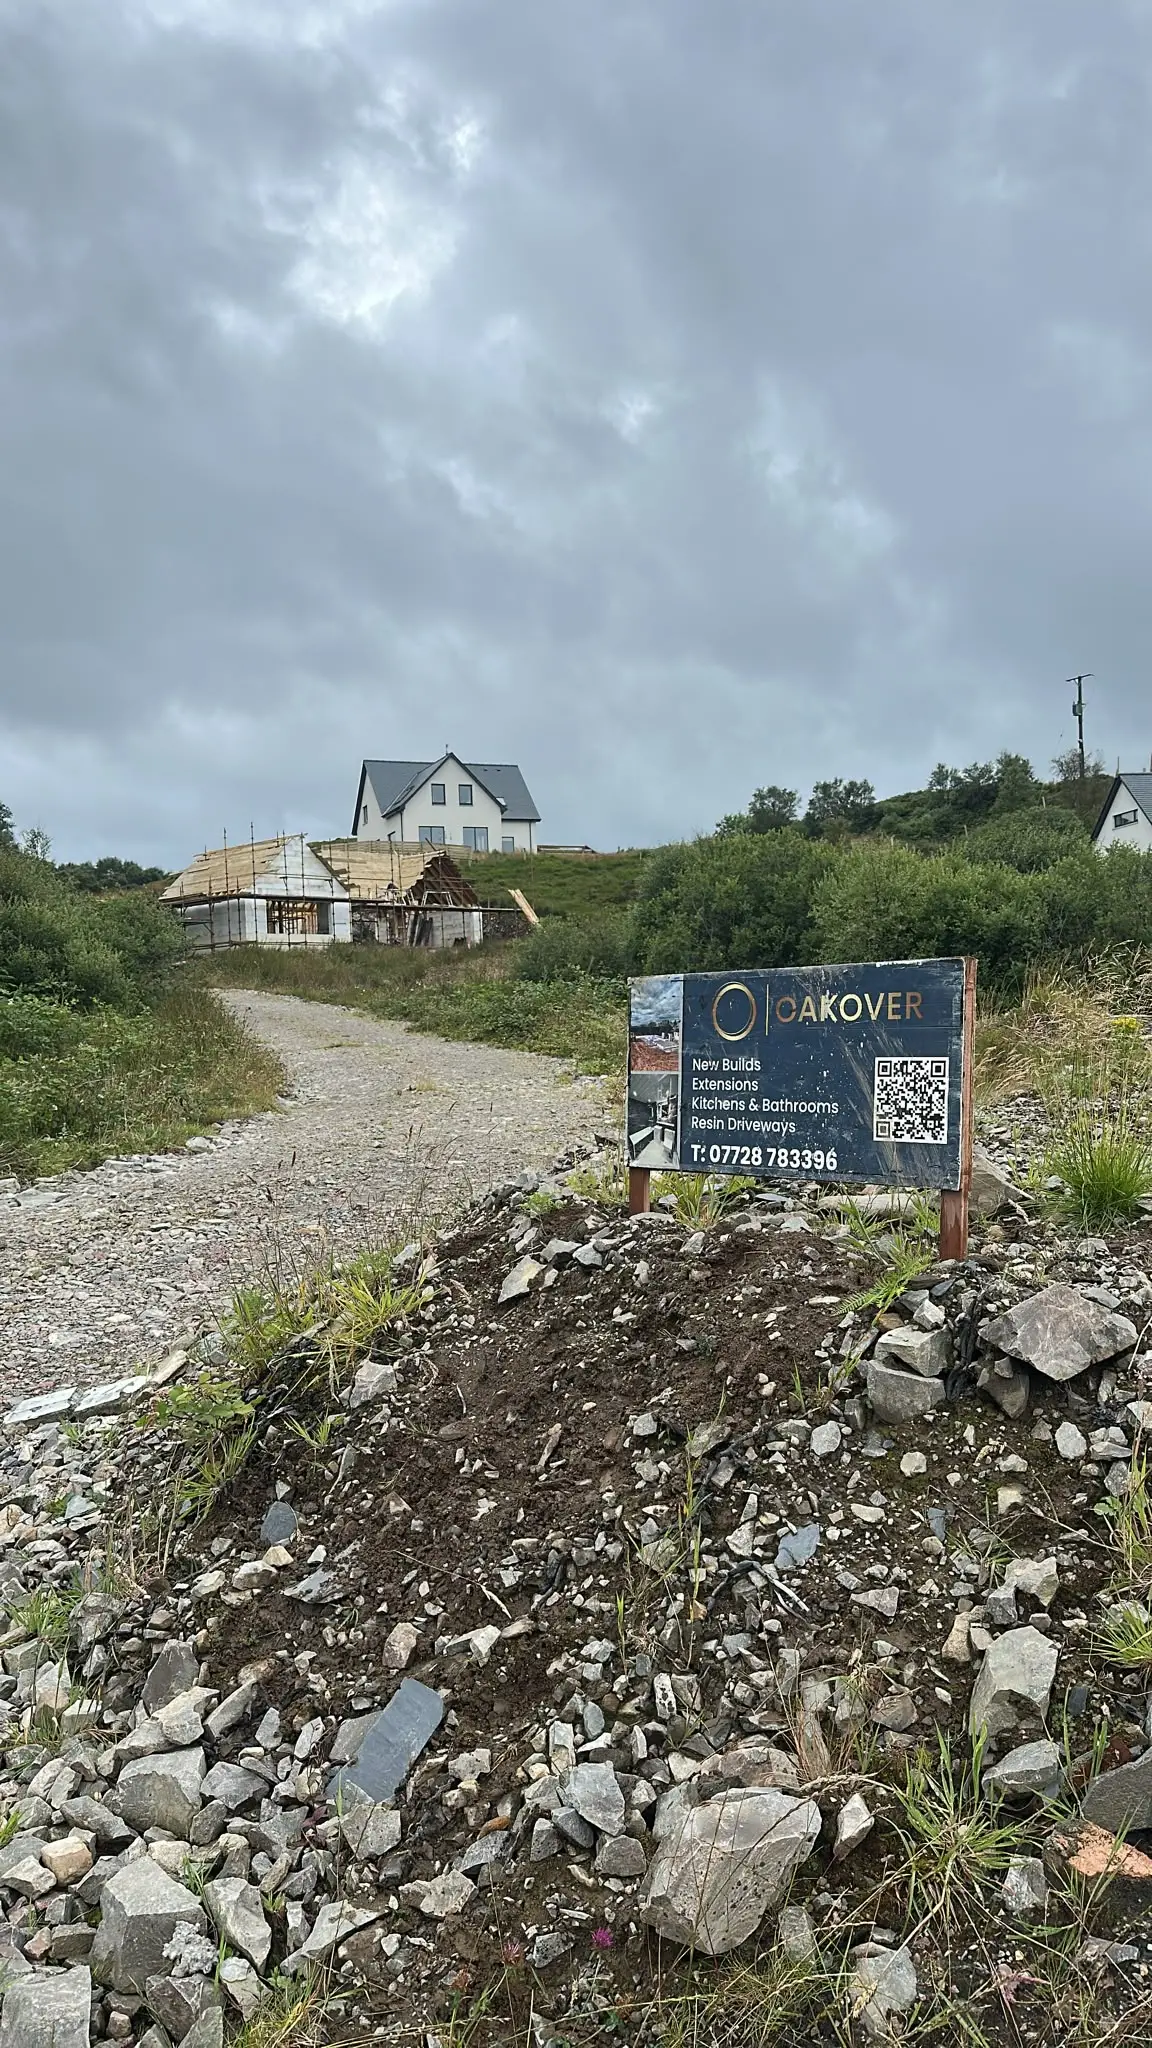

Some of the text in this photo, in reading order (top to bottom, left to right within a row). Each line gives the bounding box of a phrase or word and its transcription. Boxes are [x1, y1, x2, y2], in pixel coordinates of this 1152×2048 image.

[775, 992, 923, 1023] OAKOVER
[692, 1057, 761, 1072] New Builds
[692, 1078, 759, 1092] Extensions
[691, 1097, 839, 1115] Kitchens & Bathrooms
[691, 1117, 796, 1136] Resin Driveways
[691, 1144, 838, 1171] T: 07728 783396
